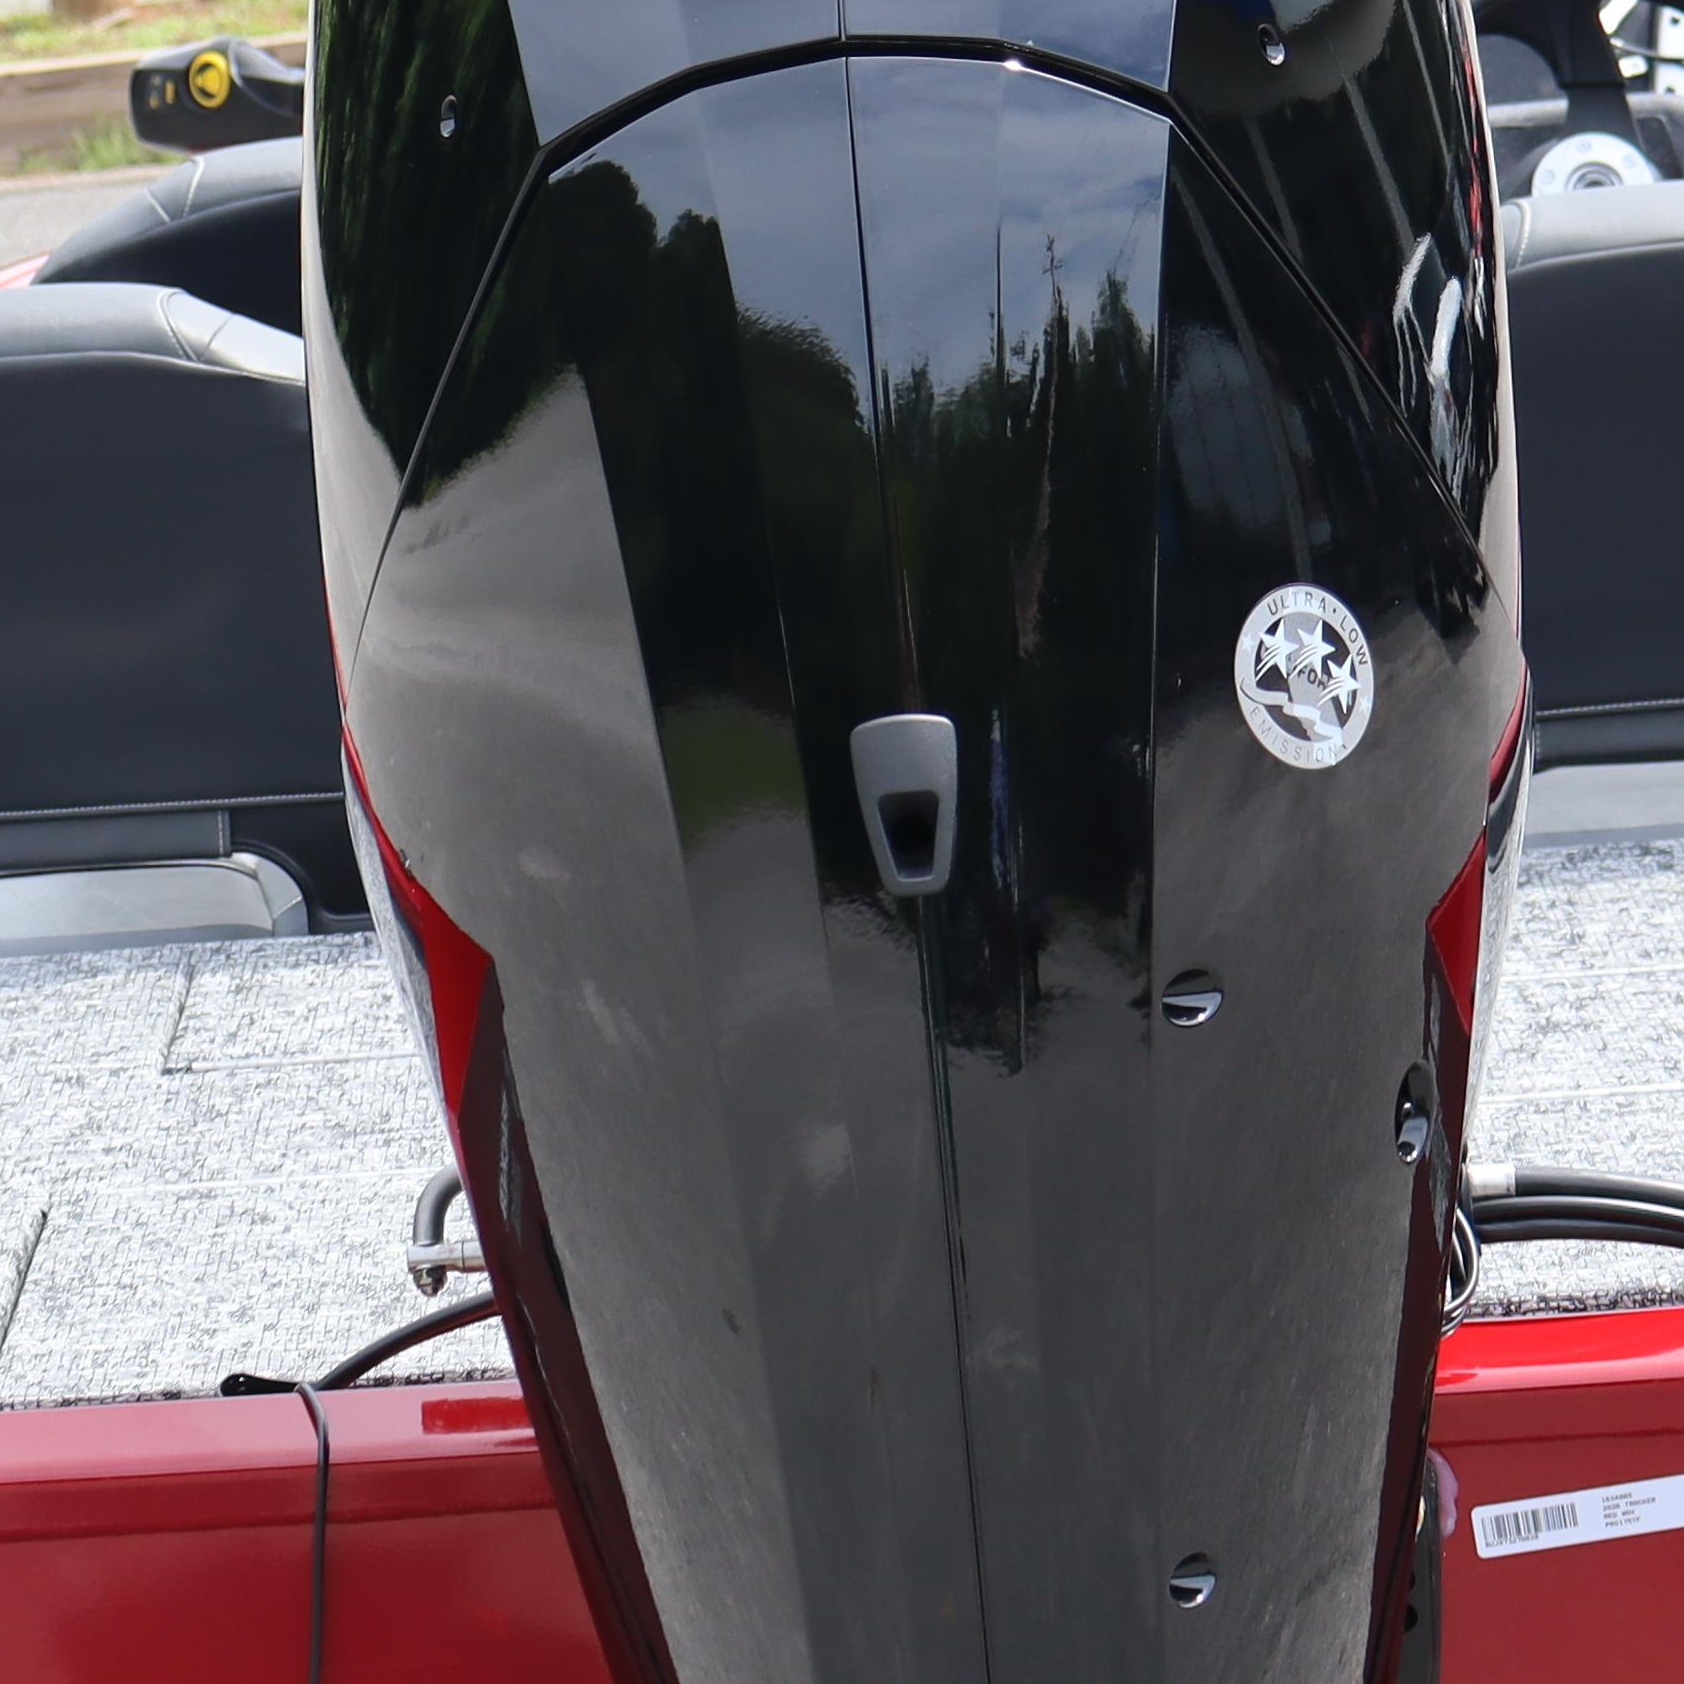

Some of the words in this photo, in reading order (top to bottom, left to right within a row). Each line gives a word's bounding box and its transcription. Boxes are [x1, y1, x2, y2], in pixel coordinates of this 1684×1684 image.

[1267, 591, 1326, 616] ULTRA
[1340, 615, 1368, 665] LOW
[1249, 705, 1340, 762] EMISSION
[1625, 1497, 1657, 1508] TRACKER
